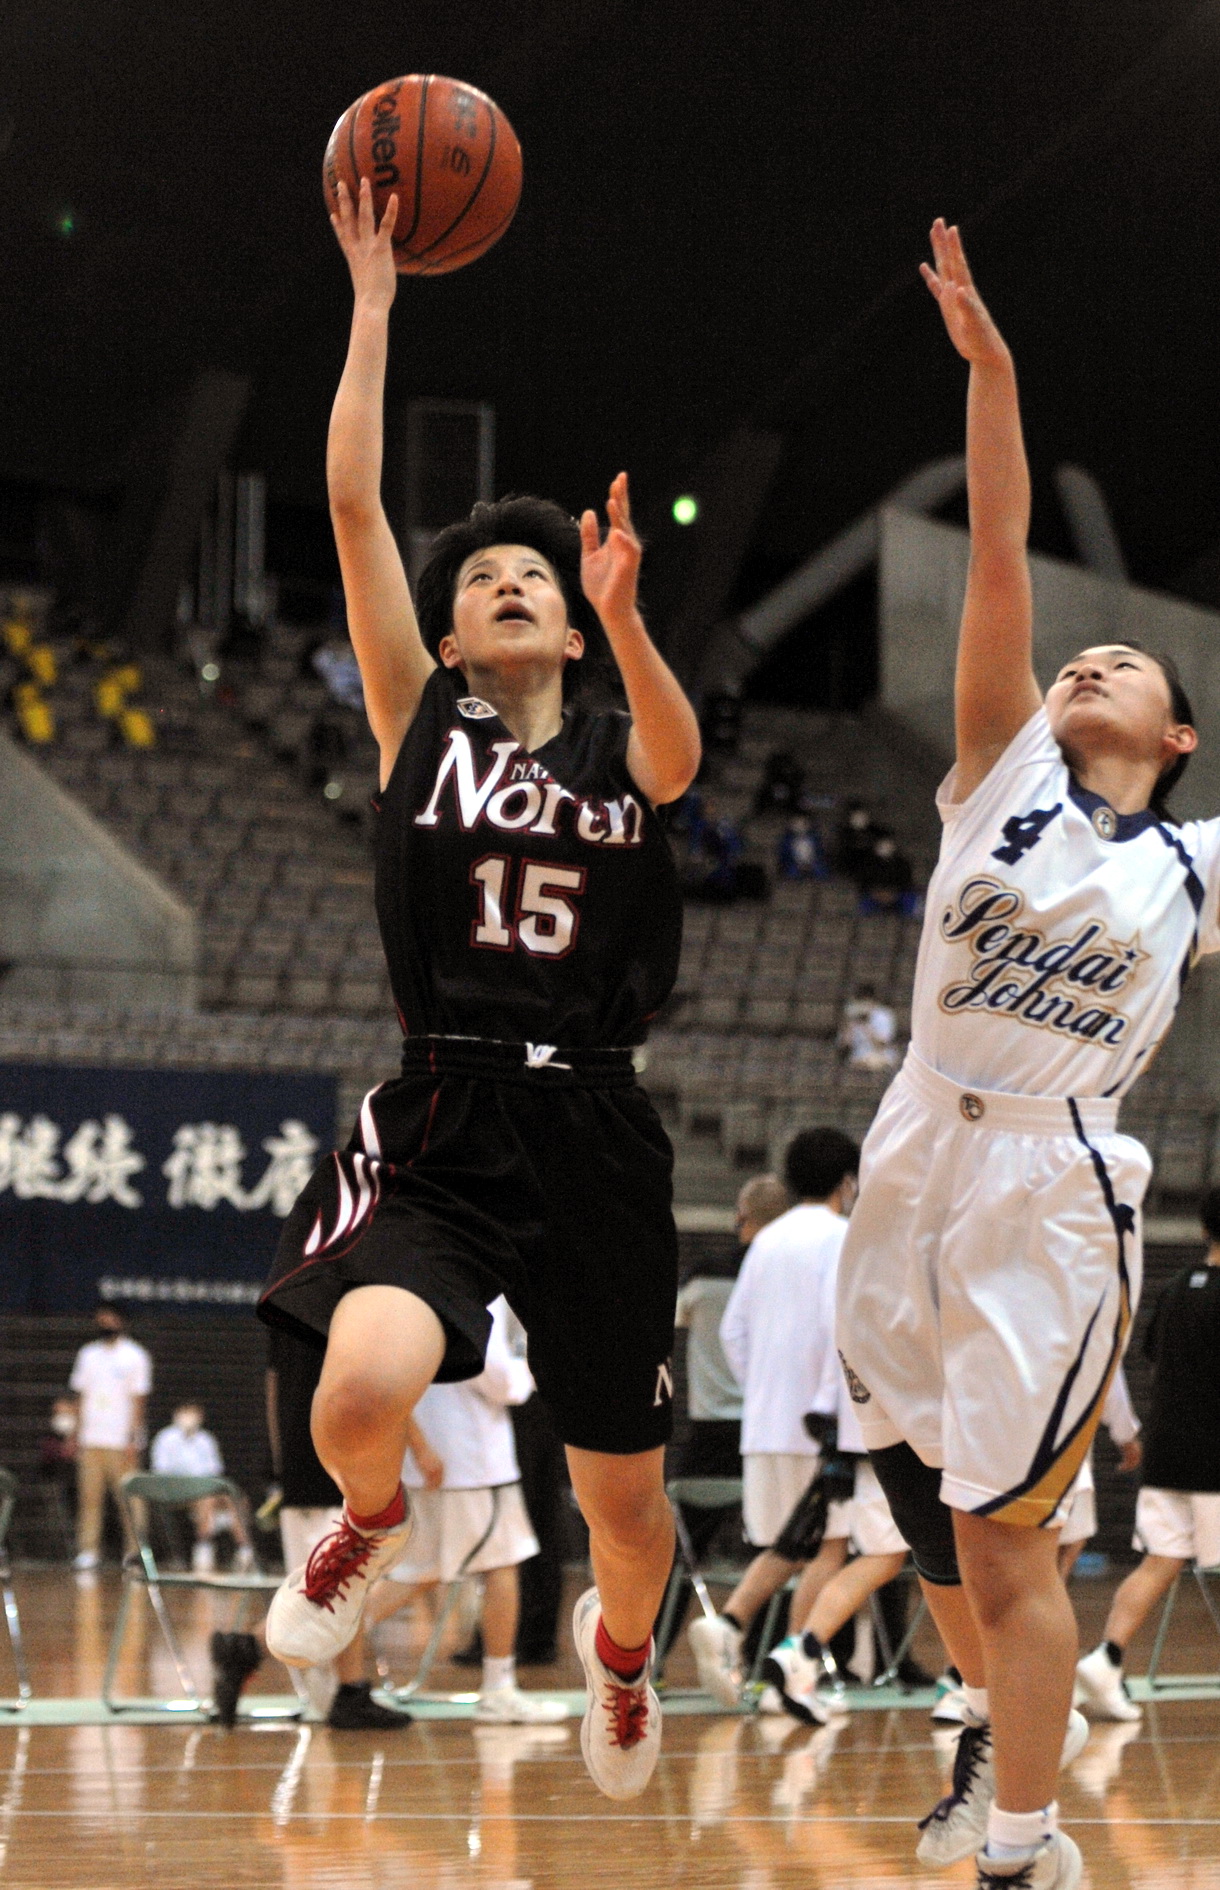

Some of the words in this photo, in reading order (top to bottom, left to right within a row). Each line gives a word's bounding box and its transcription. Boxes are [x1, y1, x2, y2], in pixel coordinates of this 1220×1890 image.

[990, 802, 1064, 866] 4
[472, 855, 584, 957] 15
[942, 878, 1129, 994] Sendai
[942, 957, 1126, 1045] Johnan
